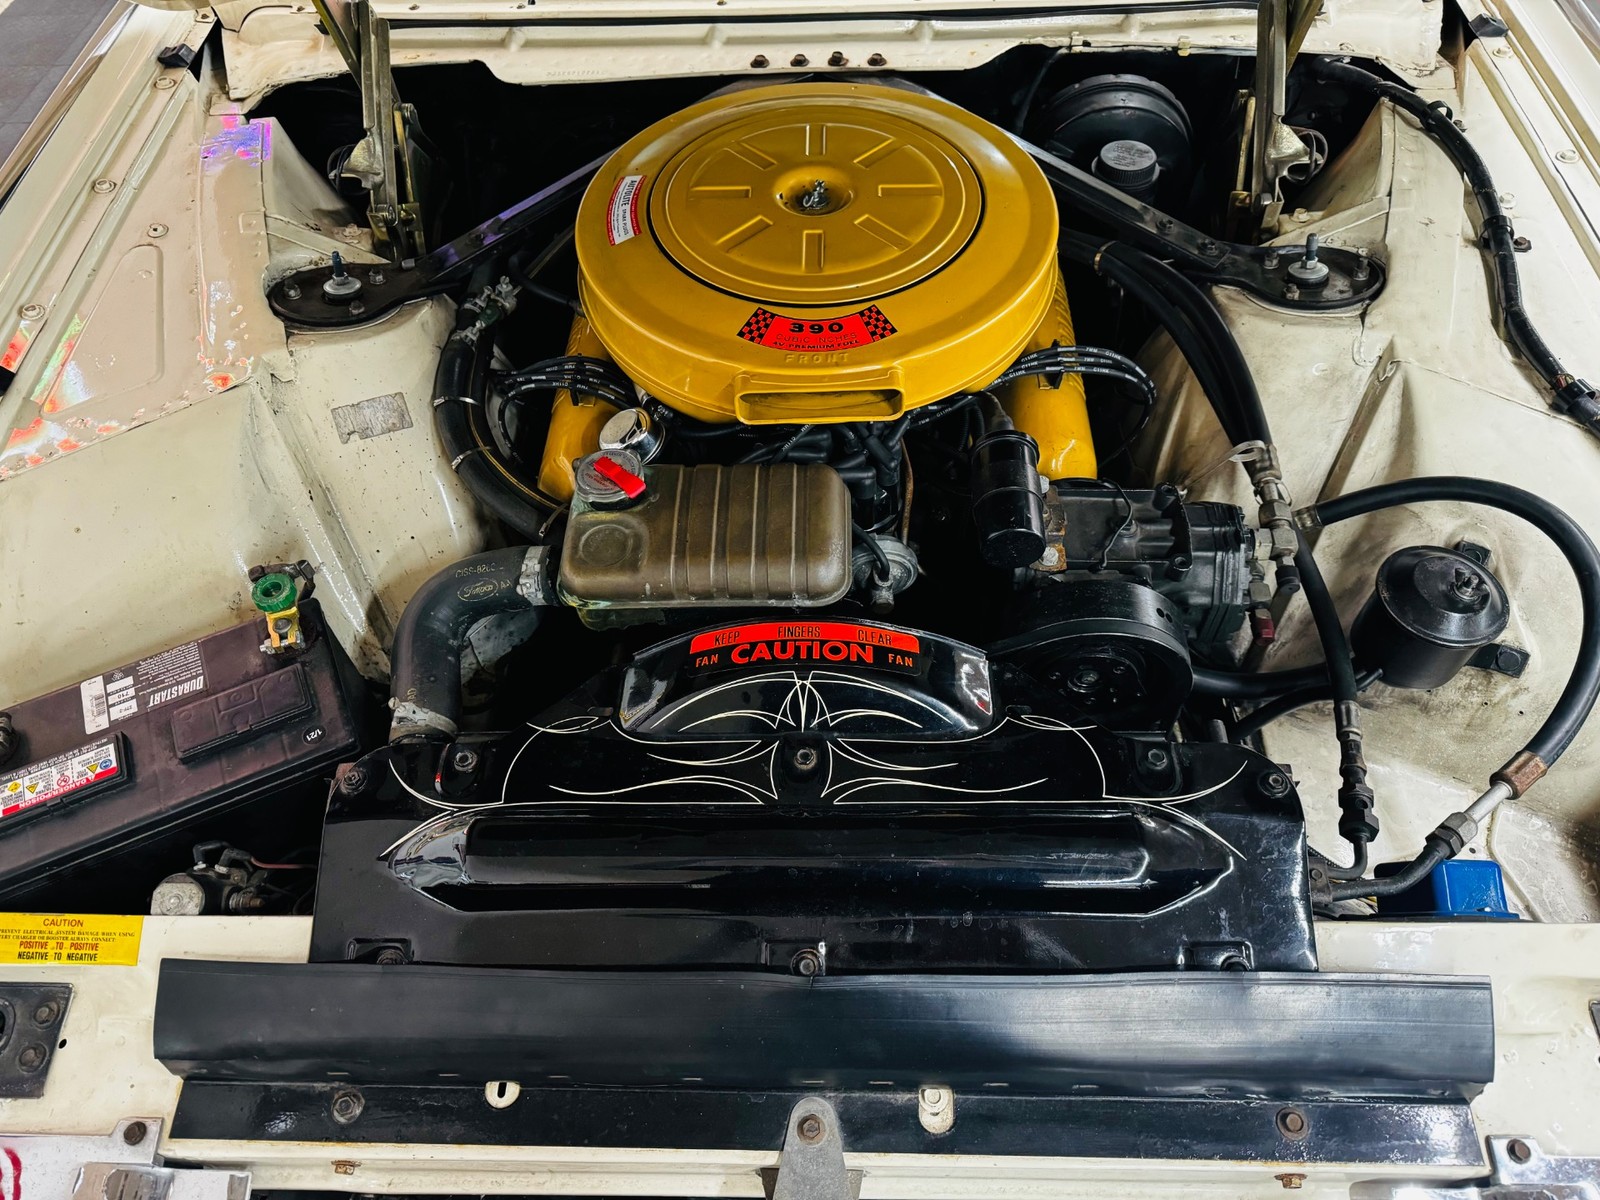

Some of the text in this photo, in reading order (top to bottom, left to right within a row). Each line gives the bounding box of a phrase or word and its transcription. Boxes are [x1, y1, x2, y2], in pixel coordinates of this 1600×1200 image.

[789, 322, 844, 334] 390
[816, 332, 857, 343] NCHES
[785, 352, 849, 364] FRONT
[714, 626, 892, 646] KEEP FINGERS CLEAR
[695, 641, 913, 668] FAN CAUTION FAN
[147, 675, 204, 708] DURASTART
[306, 729, 322, 741] 1/21
[43, 918, 84, 927] CAUTION
[19, 941, 99, 951] POSITIVE TO POSITIVE
[17, 951, 98, 962] NEGATIVE TO NEGATIVE
